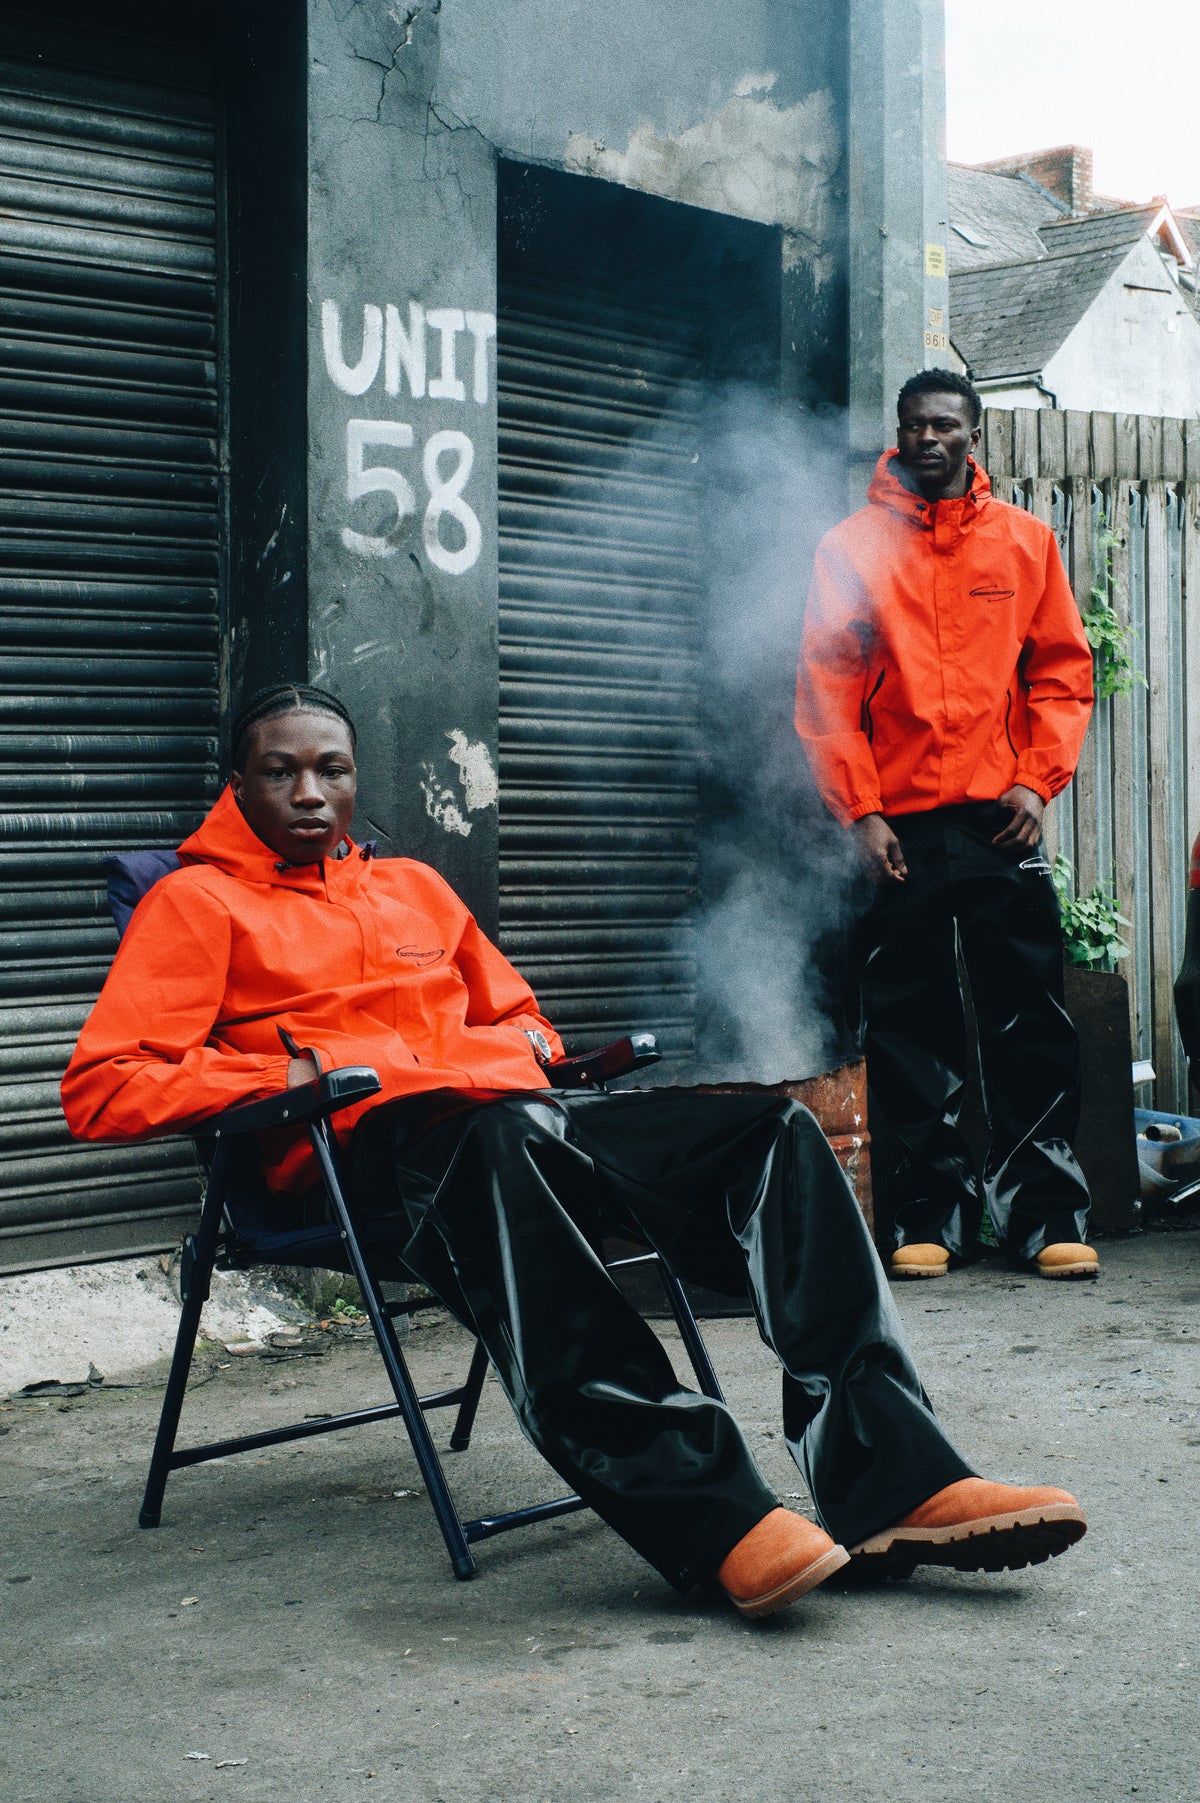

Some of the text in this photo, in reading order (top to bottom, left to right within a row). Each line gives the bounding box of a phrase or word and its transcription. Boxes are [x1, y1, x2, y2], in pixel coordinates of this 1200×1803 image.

[321, 299, 497, 404] UNIT
[925, 333, 946, 348] 861
[341, 418, 482, 575] 58
